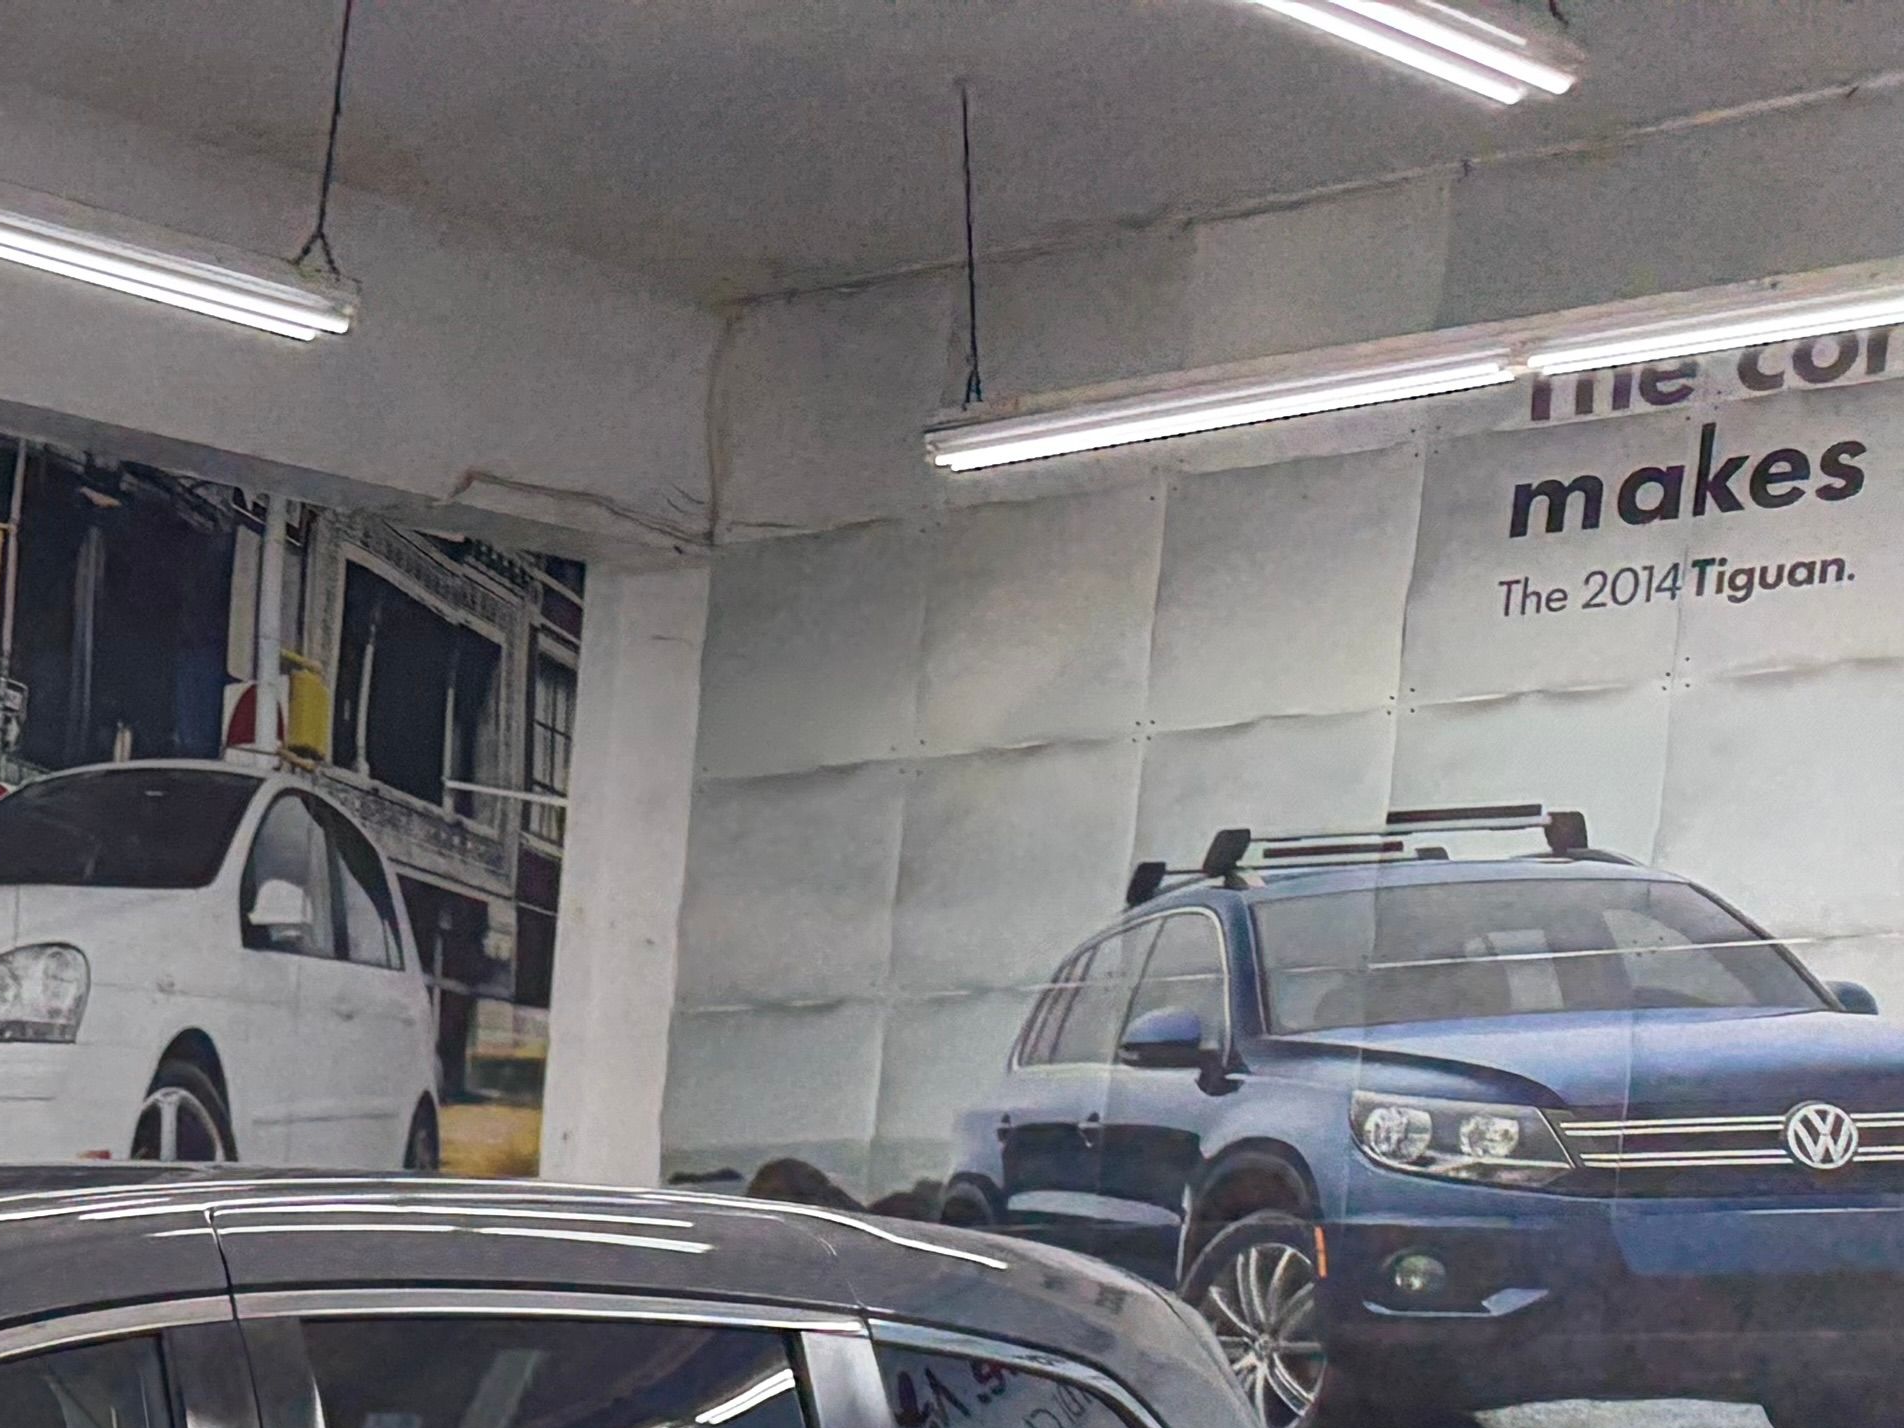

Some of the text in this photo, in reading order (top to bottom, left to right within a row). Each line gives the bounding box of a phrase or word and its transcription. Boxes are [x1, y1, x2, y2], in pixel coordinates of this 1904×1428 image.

[1509, 422, 1868, 538] makes
[1498, 557, 1856, 617] The 2014 Tiguan.
